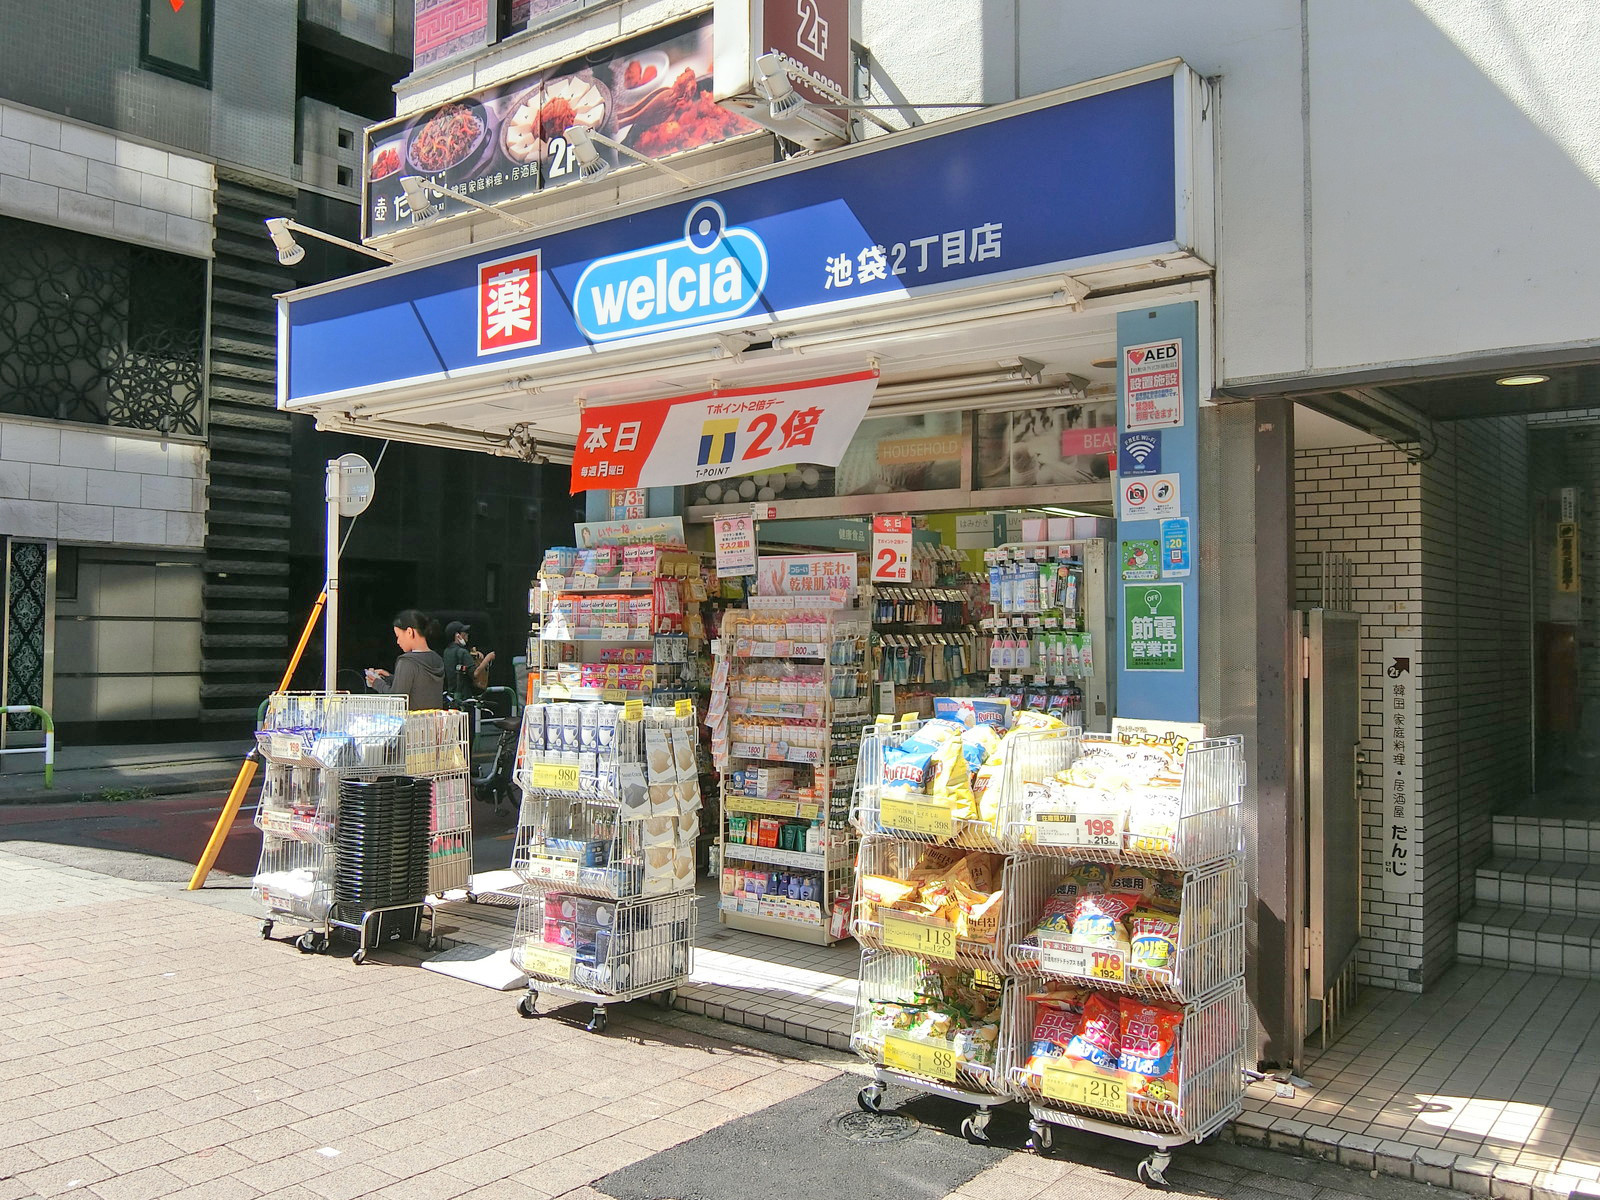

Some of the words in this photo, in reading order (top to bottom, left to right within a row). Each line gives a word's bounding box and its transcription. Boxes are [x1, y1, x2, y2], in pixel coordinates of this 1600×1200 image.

[797, 0, 829, 61] 2F
[374, 197, 388, 222] 壺
[823, 222, 1004, 291] 池袋2丁目店
[590, 255, 743, 326] welcia
[486, 268, 531, 340] 薬
[1144, 346, 1177, 362] AED
[1129, 372, 1178, 391] 設置施設
[706, 399, 785, 416] Tポイント2倍デー
[583, 420, 642, 454] 本日
[741, 406, 825, 462] 2倍
[1124, 434, 1140, 446] FREE
[1141, 434, 1157, 444] Wi-Fi
[882, 439, 959, 459] HOUSEHOLD
[580, 460, 624, 478] 毎週月曜日
[695, 466, 731, 479] T-POINT
[883, 518, 903, 529] 本日
[960, 519, 989, 529] はみがき
[996, 523, 1002, 538] 1
[719, 539, 750, 549] マスク着用
[838, 528, 866, 542] 健康食品
[875, 547, 898, 578] 2
[897, 567, 907, 579] 倍
[789, 576, 852, 592] 乾燥肌対策
[1146, 594, 1159, 602] OFF
[1131, 615, 1177, 641] 節電
[1131, 640, 1177, 658] 営業中
[978, 711, 1003, 723] RUFFLES
[558, 768, 577, 782] 980
[1084, 819, 1115, 837] 198
[1391, 824, 1408, 877] だんじ
[925, 928, 951, 947] 118
[1132, 939, 1169, 959] のり塩
[1091, 951, 1121, 971] 178
[1040, 1013, 1075, 1032] BIG
[1127, 1019, 1159, 1041] BIG
[1033, 1025, 1075, 1047] BAG
[1120, 1034, 1161, 1059] BAG
[933, 1050, 952, 1069] 88
[1090, 1080, 1120, 1101] 218
